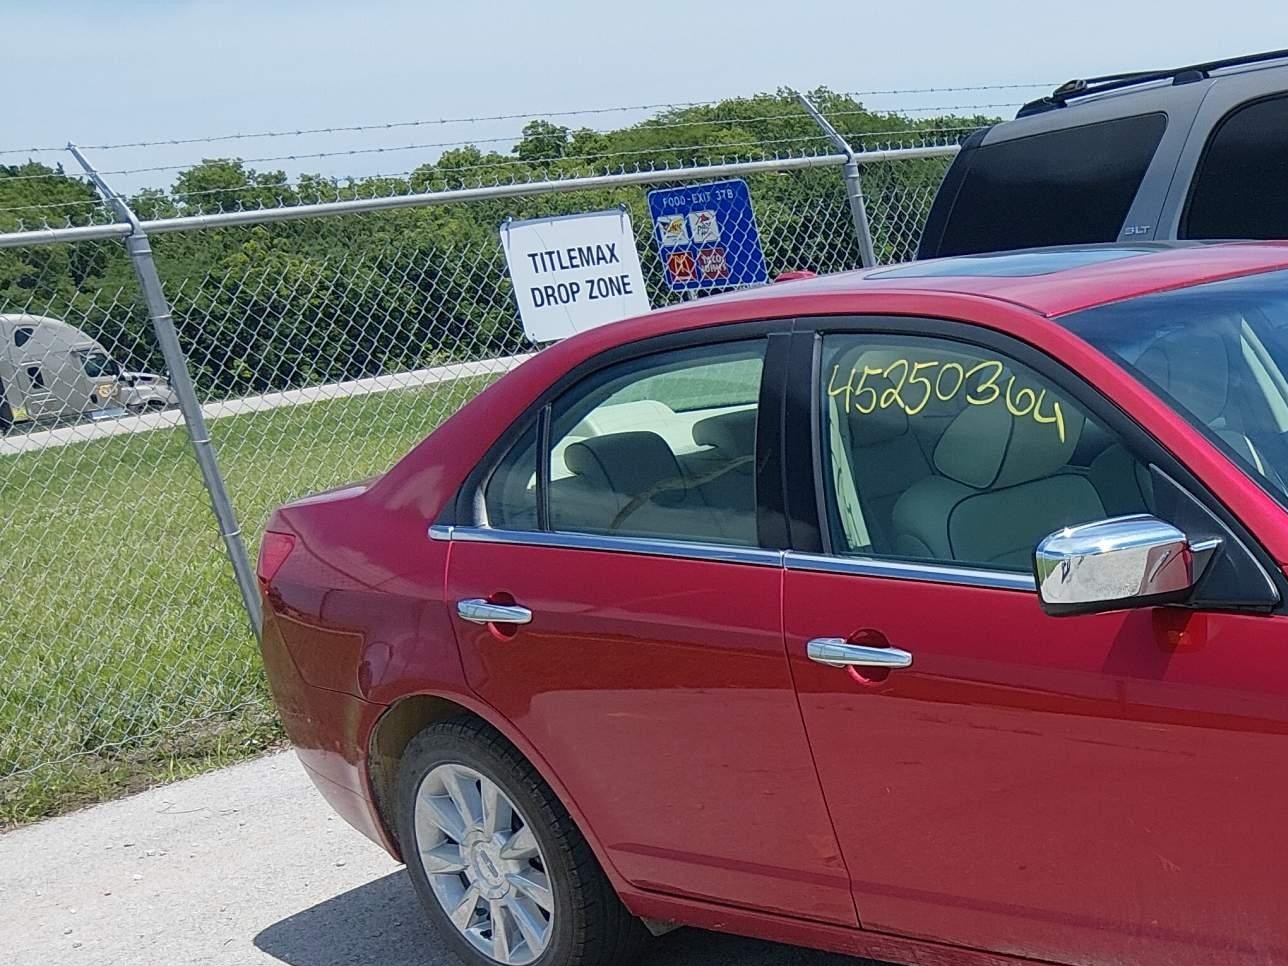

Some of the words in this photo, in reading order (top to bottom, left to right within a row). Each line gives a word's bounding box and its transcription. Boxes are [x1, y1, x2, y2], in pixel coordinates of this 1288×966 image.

[715, 189, 734, 201] 37B
[527, 243, 620, 274] TITLEMAX
[530, 281, 581, 308] DROP
[585, 274, 633, 300] ZONE
[827, 359, 1065, 443] 45250364
